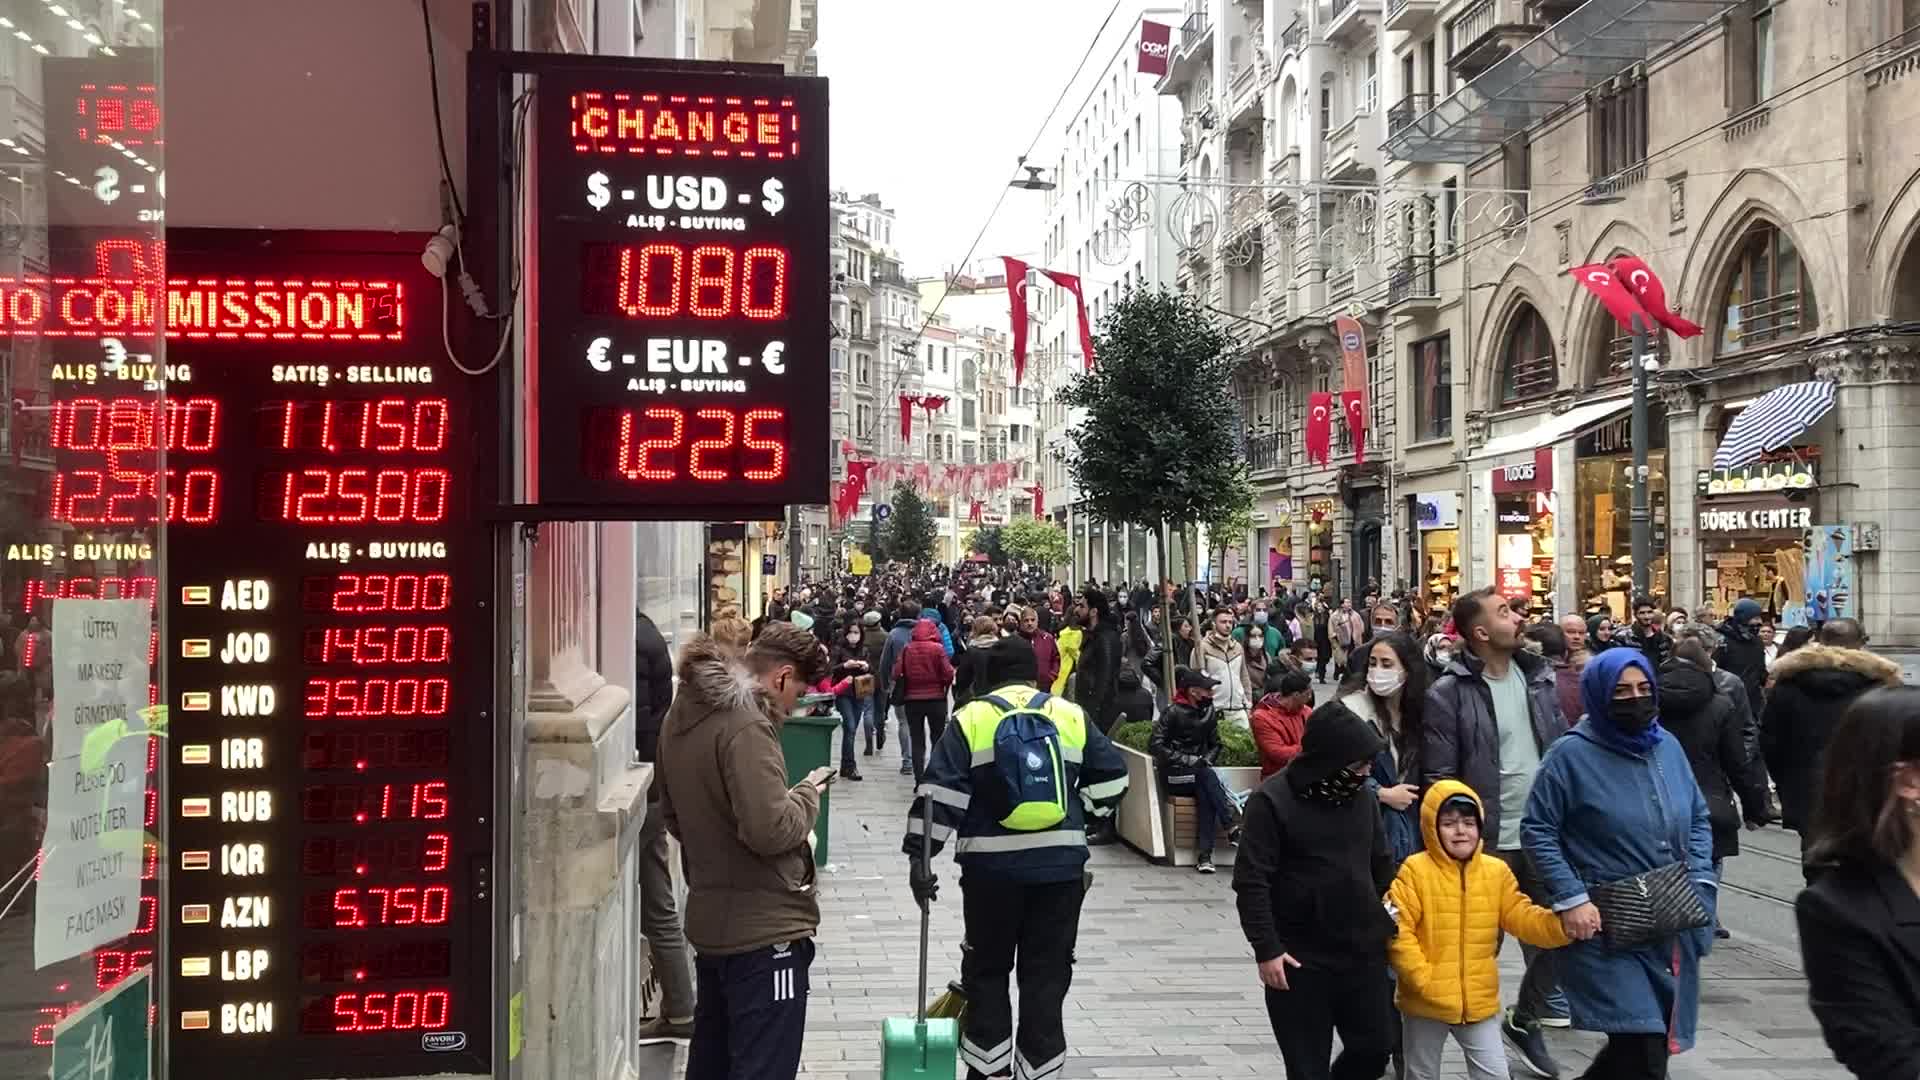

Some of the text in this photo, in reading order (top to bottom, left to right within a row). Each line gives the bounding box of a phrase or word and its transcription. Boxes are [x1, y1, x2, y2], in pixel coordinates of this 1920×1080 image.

[582, 107, 780, 145] CHANGE
[587, 171, 611, 212] $
[646, 174, 728, 211] USD
[762, 176, 785, 217] $
[626, 214, 666, 232] ALIŞ
[679, 215, 746, 231] BUYING
[62, 288, 364, 331] COMMISSION
[587, 337, 612, 372] €
[647, 338, 729, 374] EUR
[761, 340, 785, 375] €
[51, 364, 97, 385] ALIŞ
[117, 364, 192, 381] BUYNG
[271, 365, 329, 387] SATIŞ
[347, 365, 433, 384] SELLING
[626, 378, 667, 395] ALIŞ
[680, 378, 746, 393] BUYING
[1699, 507, 1812, 532] BÖREK CENTER
[7, 543, 54, 565] ALIŞ
[73, 544, 152, 560] BUYING
[305, 543, 351, 563] ALIŞ
[369, 542, 447, 558] BUYING
[221, 579, 270, 610] AED
[220, 632, 271, 663] JOD
[221, 685, 276, 716] KWD
[221, 738, 264, 769] IRR
[221, 790, 272, 822] RUB
[221, 843, 265, 876] IQR
[221, 896, 270, 928] AZN
[221, 949, 269, 981] LBP
[221, 1002, 273, 1033] BGN
